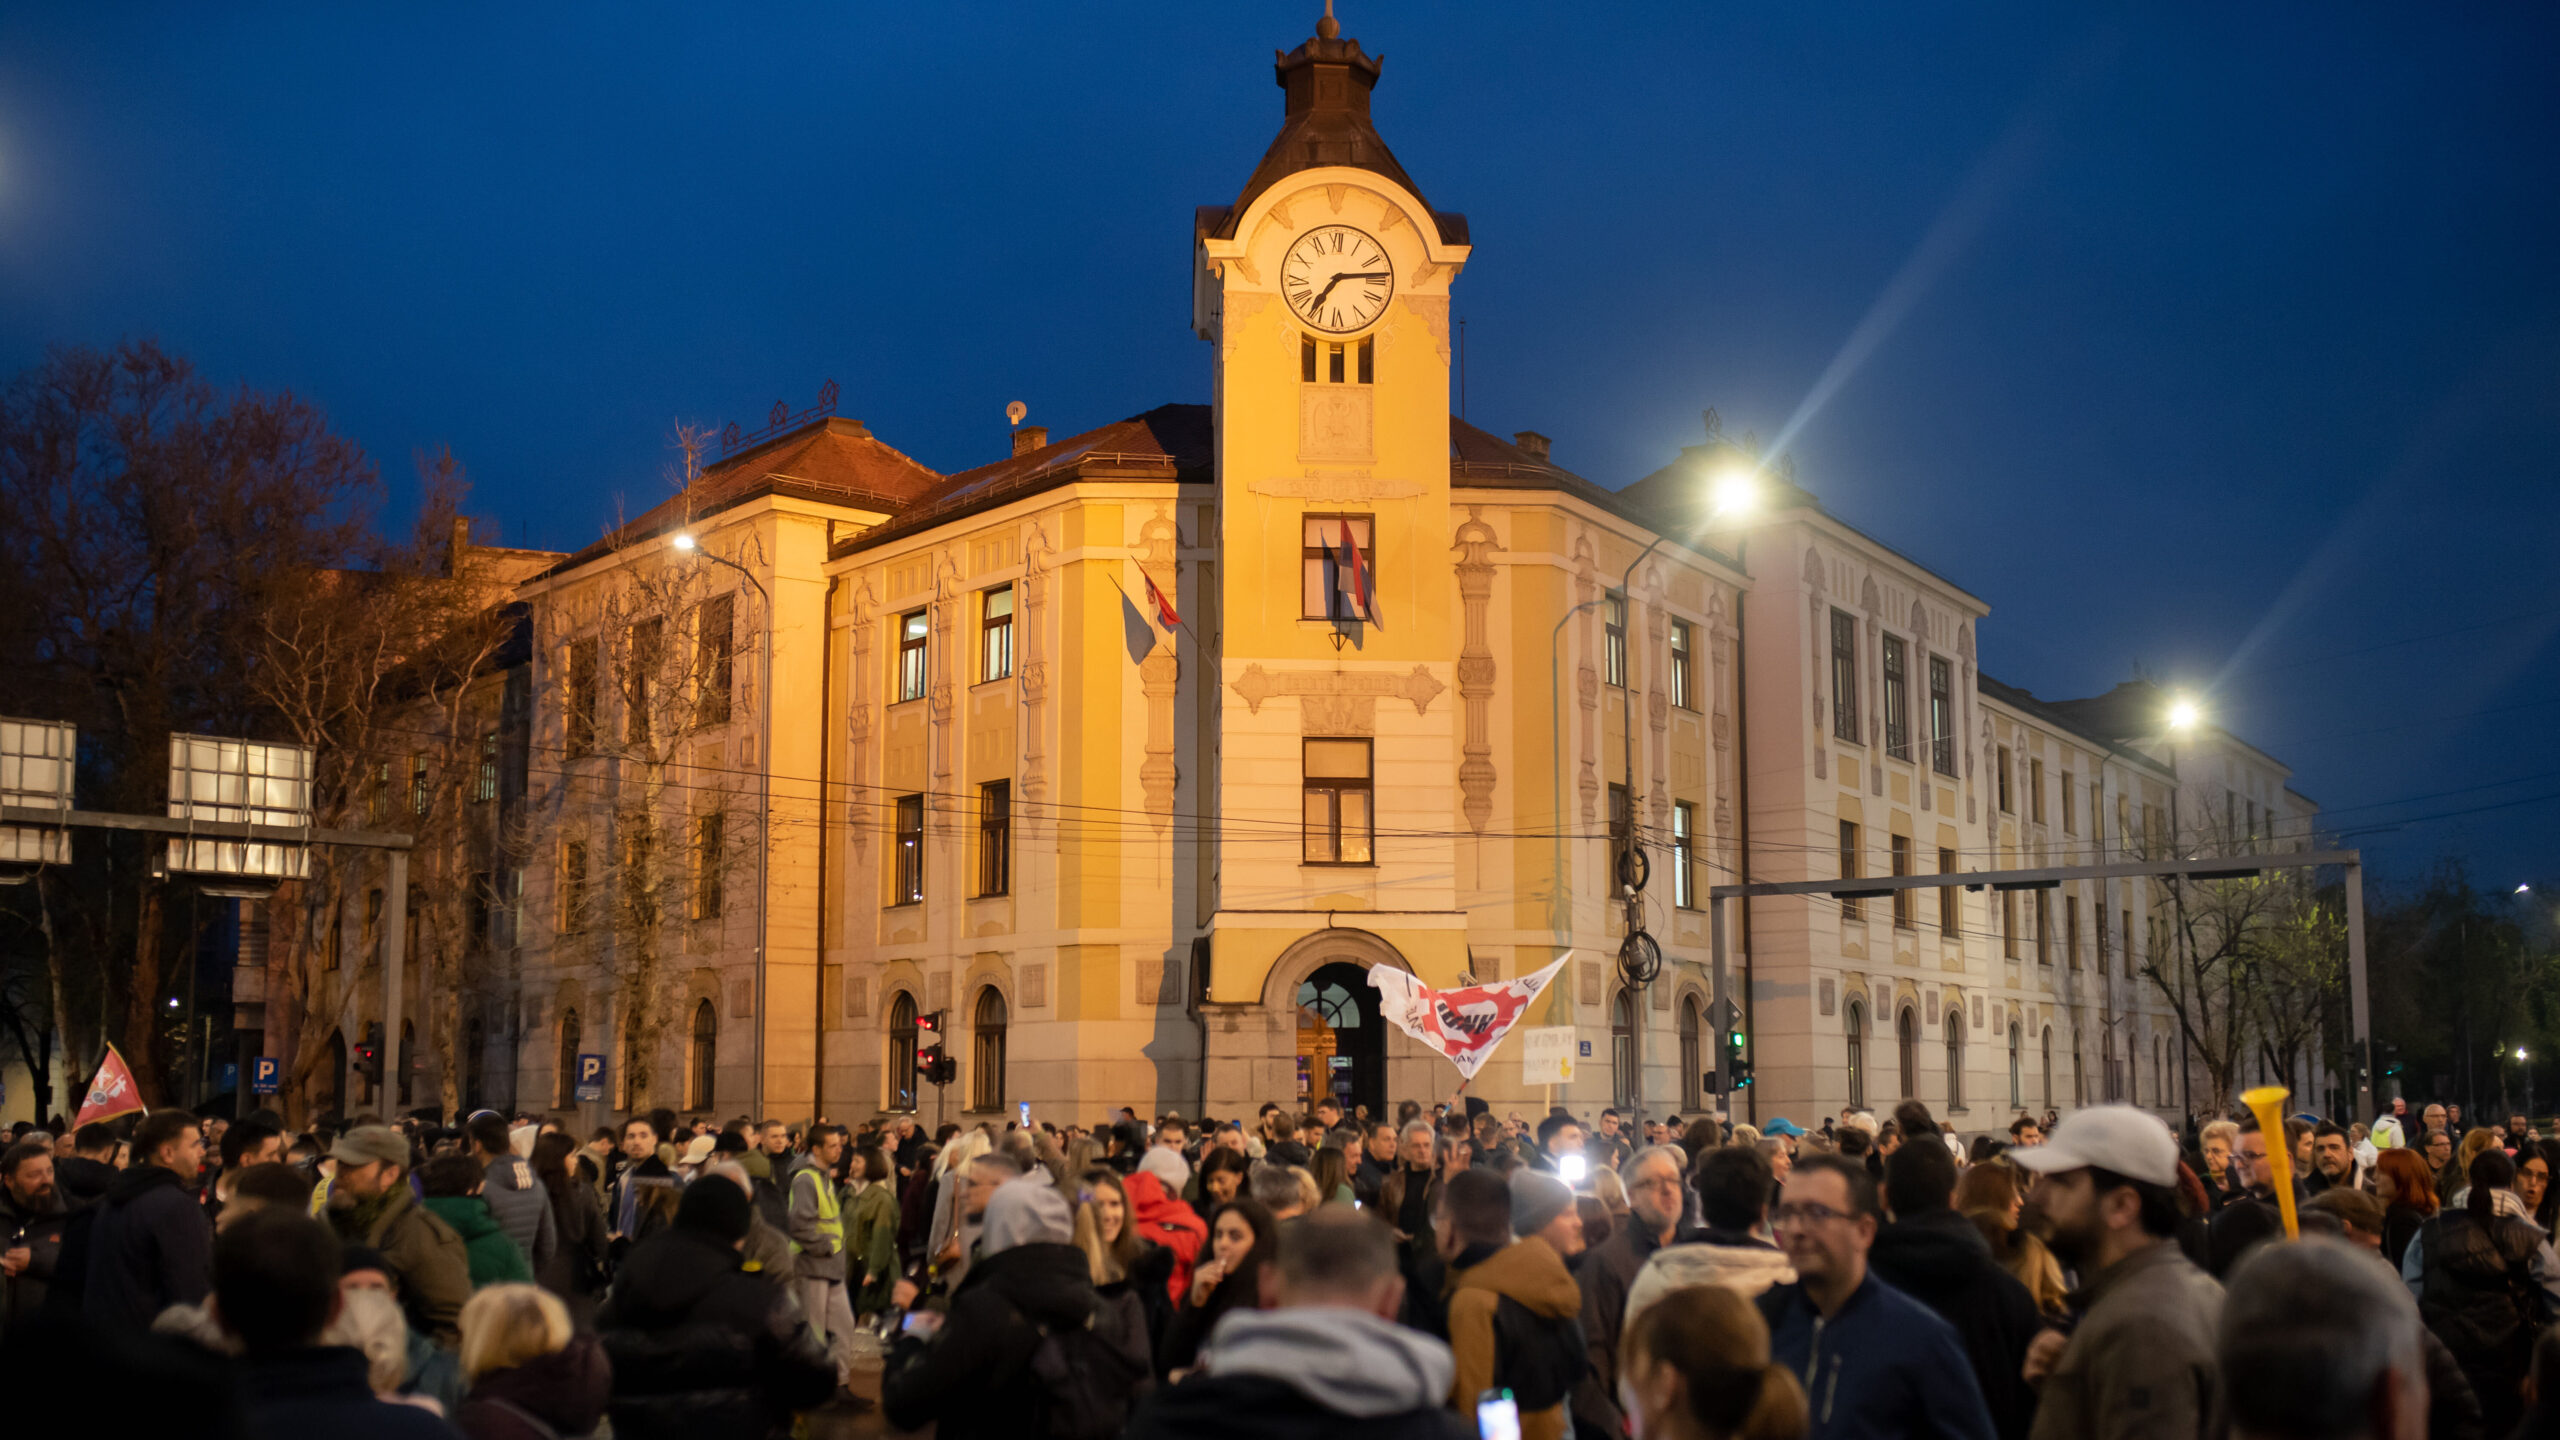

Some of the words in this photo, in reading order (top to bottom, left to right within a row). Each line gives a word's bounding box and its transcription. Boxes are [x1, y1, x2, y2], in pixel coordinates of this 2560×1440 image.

[1306, 236, 1326, 257] XI
[1329, 233, 1344, 253] XII
[1351, 239, 1362, 256] I
[1292, 253, 1314, 269] X
[1361, 255, 1380, 268] II
[1289, 275, 1309, 286] IX
[1366, 277, 1386, 286] III
[1293, 289, 1312, 309] VIII
[1331, 307, 1344, 327] VI
[1352, 305, 1366, 325] V
[227, 1066, 235, 1076] P
[259, 1061, 275, 1080] P
[583, 1058, 600, 1081] P
